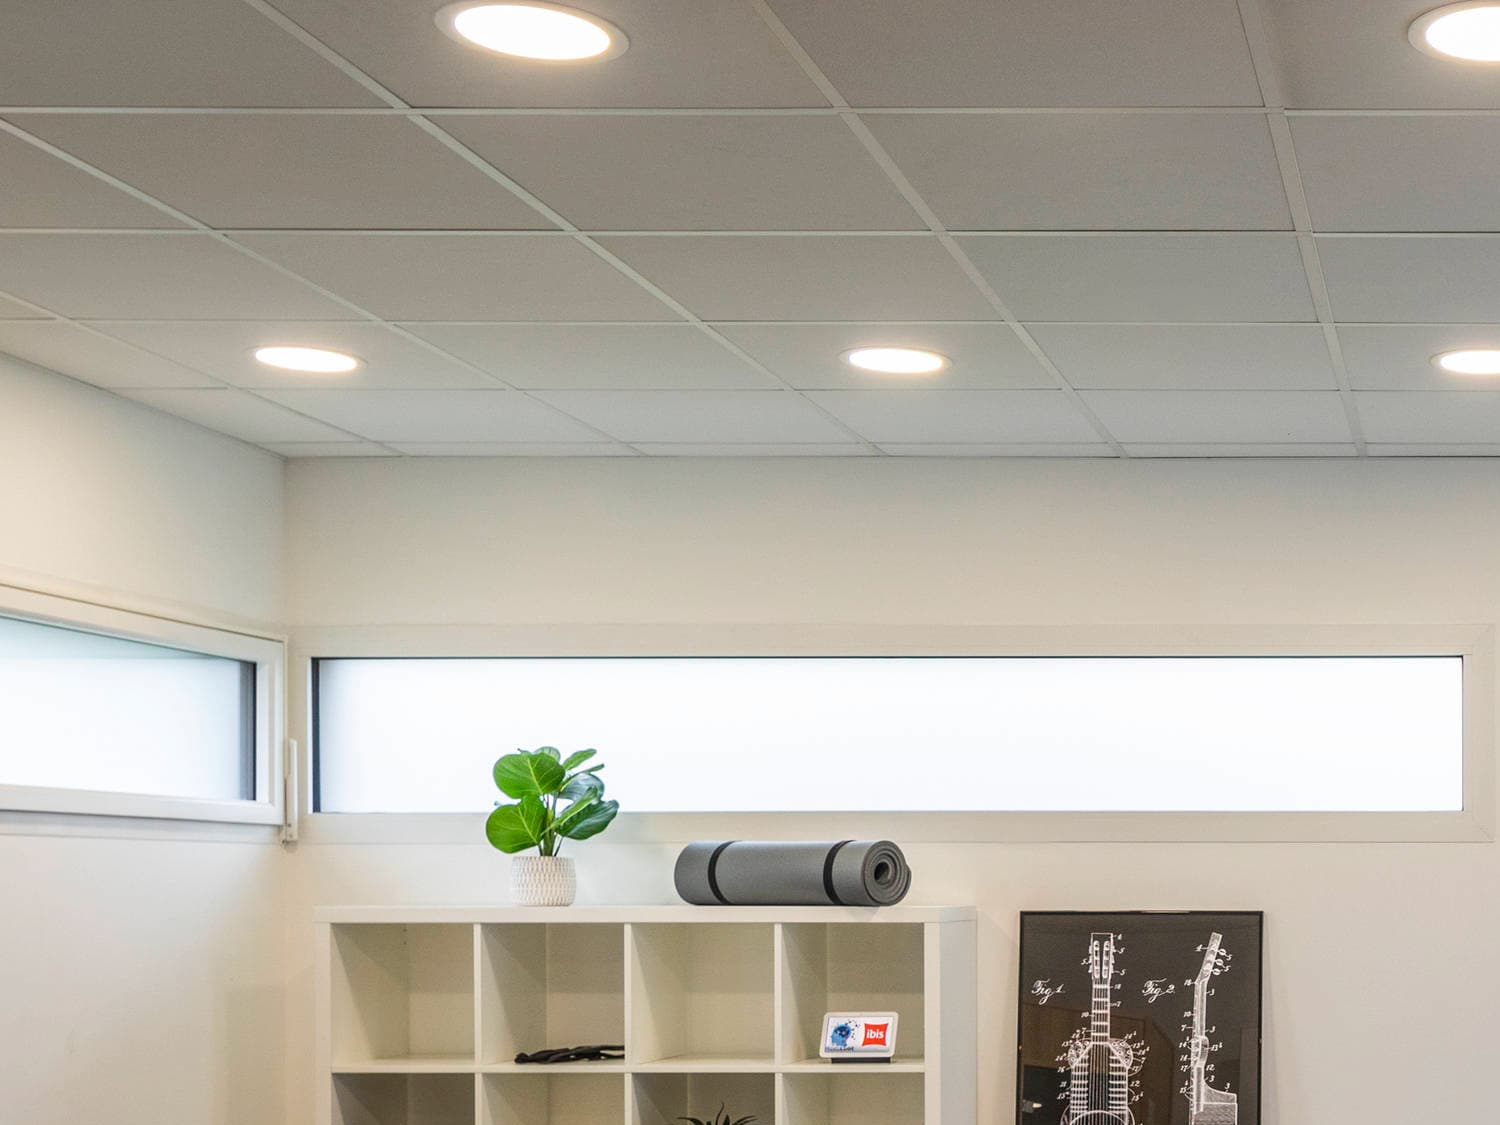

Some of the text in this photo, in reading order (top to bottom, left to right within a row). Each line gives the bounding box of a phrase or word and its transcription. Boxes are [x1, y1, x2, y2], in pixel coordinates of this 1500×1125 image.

[1056, 983, 1066, 994] 1
[1166, 984, 1175, 993] 2
[866, 1029, 884, 1039] ibis
